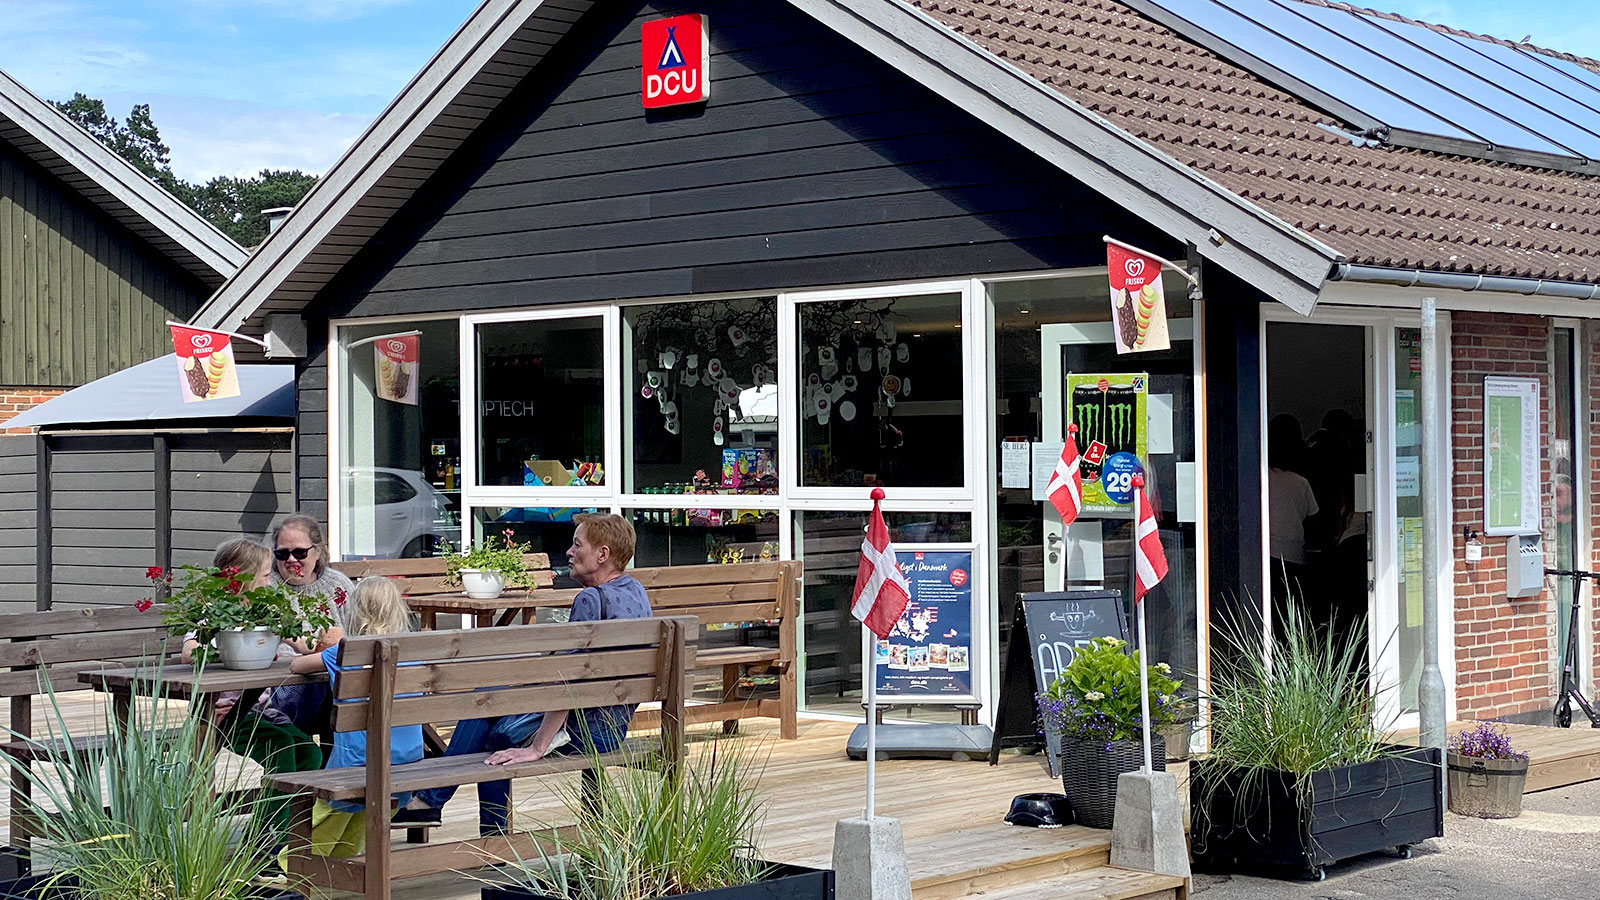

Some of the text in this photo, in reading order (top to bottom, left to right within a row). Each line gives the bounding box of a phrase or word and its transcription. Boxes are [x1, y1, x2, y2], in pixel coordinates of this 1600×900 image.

[647, 69, 697, 98] DCU
[1125, 277, 1144, 285] FRISKO
[451, 400, 534, 416] TPTECH
[1106, 472, 1132, 493] 29
